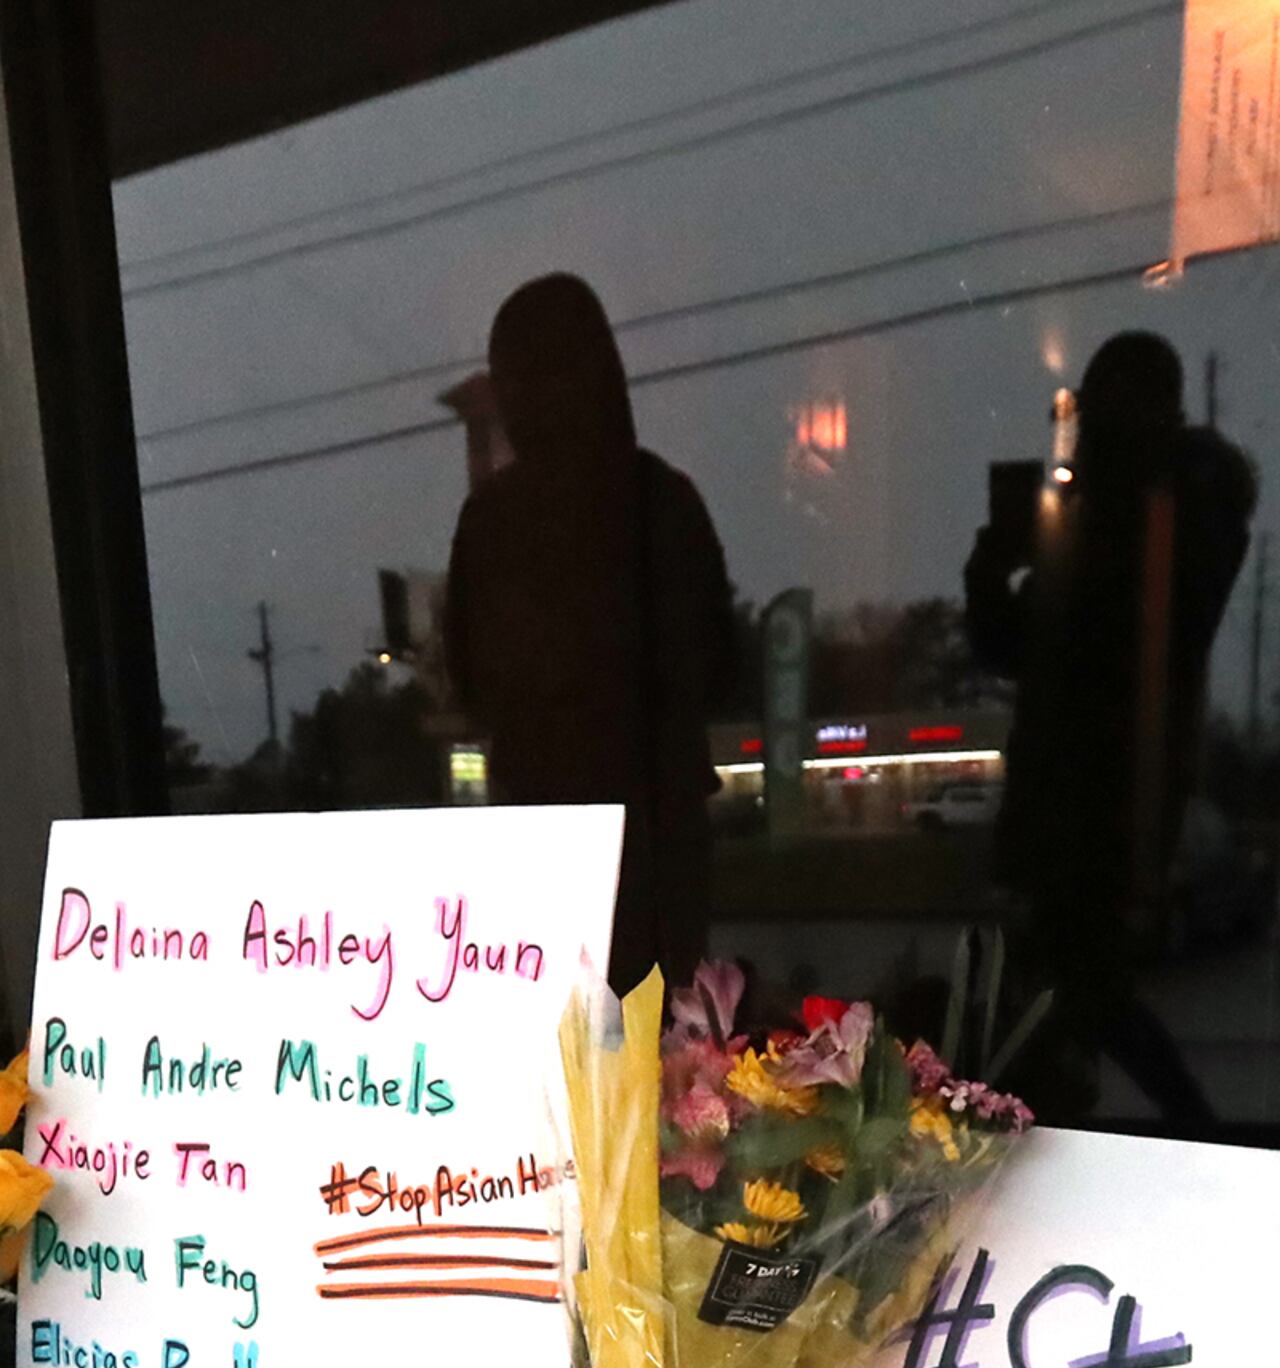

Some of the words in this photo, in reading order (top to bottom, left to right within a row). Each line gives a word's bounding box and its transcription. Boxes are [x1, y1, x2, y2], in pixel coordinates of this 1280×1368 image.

[51, 887, 210, 970] Delaina
[242, 900, 394, 1020] Ashley
[416, 895, 545, 1003] Yaun
[42, 1017, 107, 1087] Paul
[141, 1036, 244, 1099] Andre
[274, 1039, 457, 1116] Michels
[36, 1120, 152, 1196] Xiaojie
[172, 1143, 248, 1191] Tan
[30, 1212, 148, 1300] Daoyou
[173, 1235, 260, 1329] Feng
